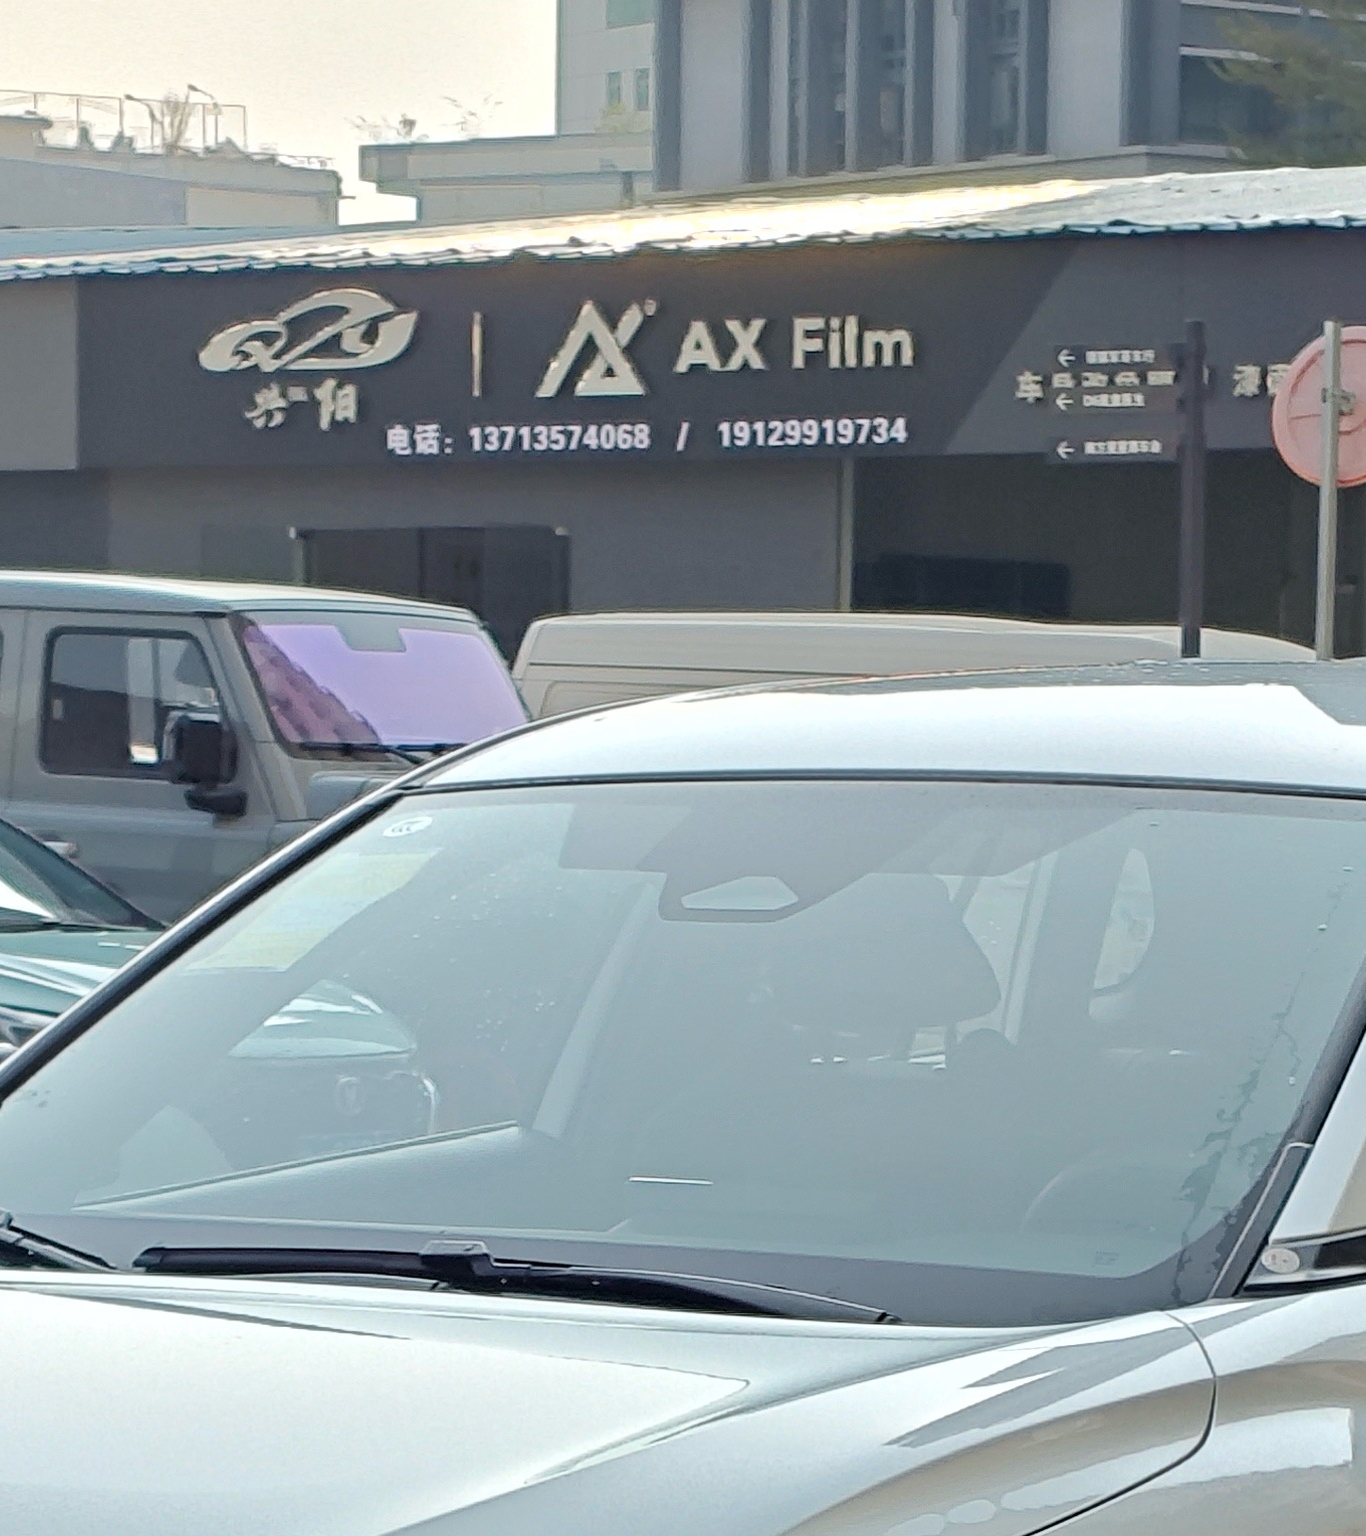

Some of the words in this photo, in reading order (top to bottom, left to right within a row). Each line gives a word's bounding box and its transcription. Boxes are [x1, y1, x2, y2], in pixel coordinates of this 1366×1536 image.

[672, 318, 768, 374] AX
[791, 314, 915, 370] Film
[468, 422, 652, 453] 13713574068
[717, 417, 909, 449] 19129919734
